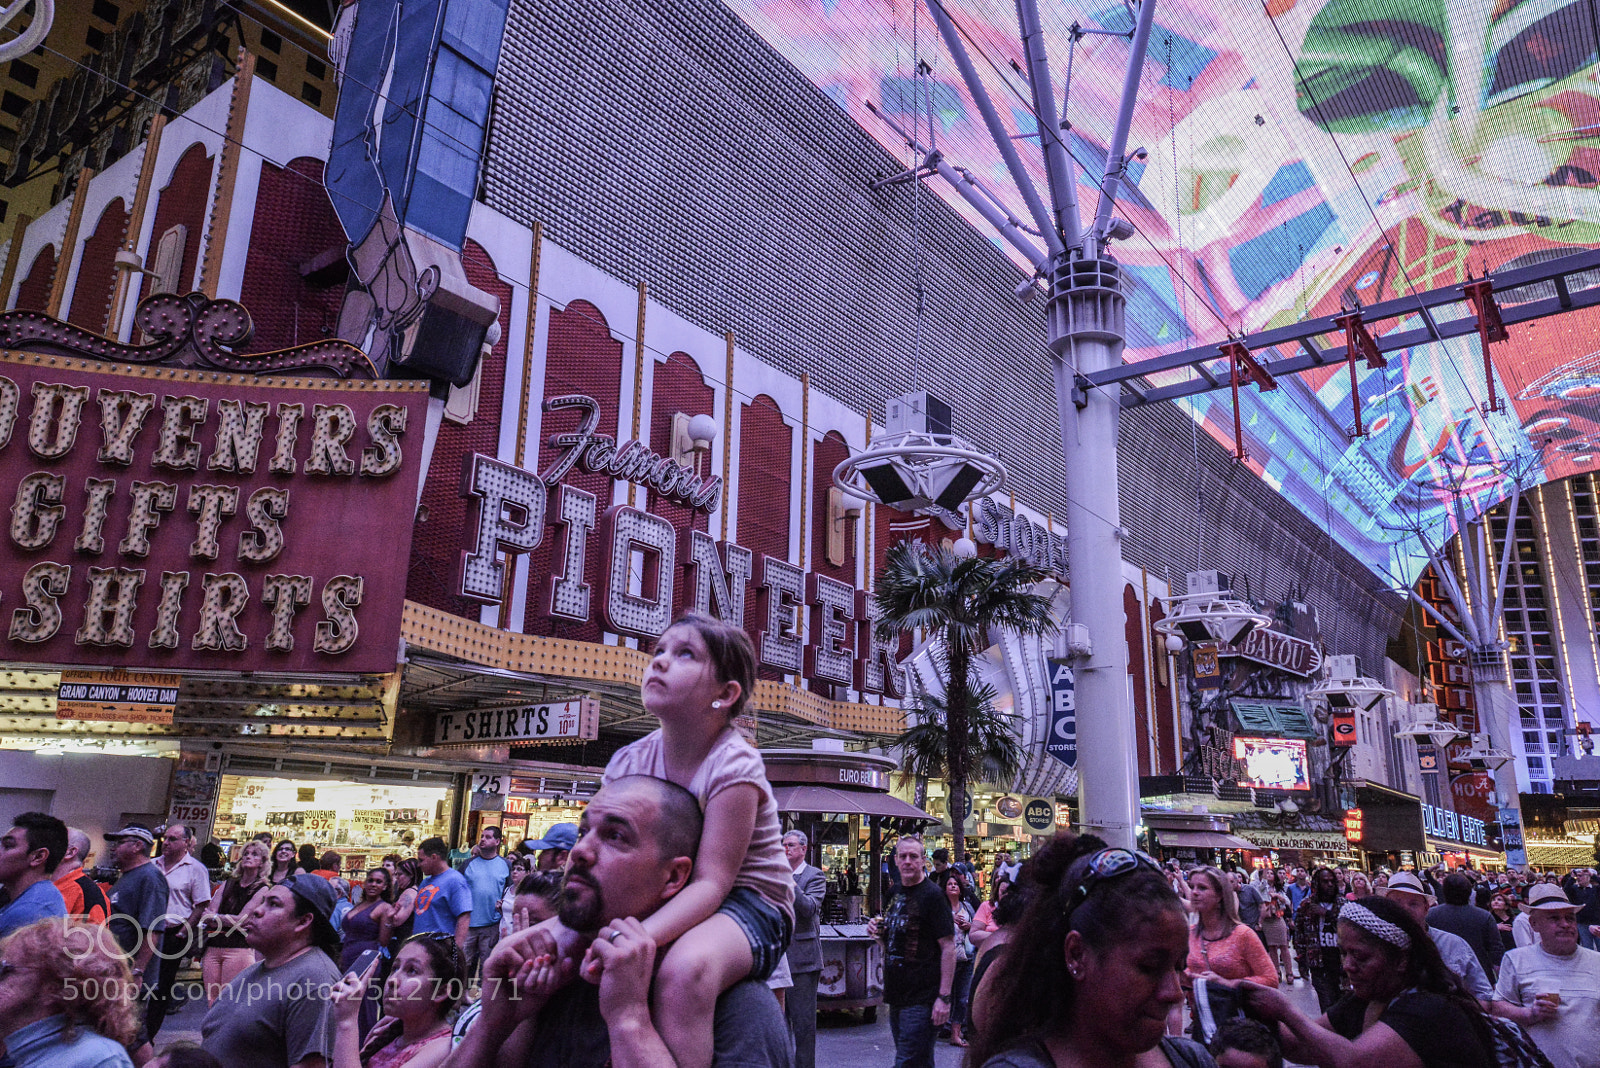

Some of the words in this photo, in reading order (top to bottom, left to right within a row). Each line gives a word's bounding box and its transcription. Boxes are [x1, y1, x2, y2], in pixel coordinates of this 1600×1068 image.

[541, 394, 723, 514] Famous
[10, 471, 291, 564] GIFTS
[456, 451, 906, 699] PIONEER
[1244, 629, 1306, 670] BAYOU
[65, 670, 93, 679] OFFICIAL
[99, 670, 129, 682] TOUR
[134, 672, 178, 685] CENTER
[60, 684, 88, 699] GRAND
[88, 686, 121, 700] CANYON
[127, 688, 159, 702] HOOVER
[159, 689, 178, 703] DAM
[563, 702, 570, 713] 4
[1052, 664, 1076, 740] ABC
[95, 712, 117, 720] PASSES
[130, 713, 148, 721] SHOW
[150, 714, 172, 722] TICKETS
[441, 706, 550, 741] T-SHIRTS
[839, 768, 859, 783] EURO
[172, 805, 209, 820] $17.99
[354, 809, 385, 818] EVERYTHING
[507, 799, 525, 813] TM
[1027, 807, 1050, 817] ABC
[304, 810, 337, 820] SOUVENIRS
[1421, 802, 1461, 841] OLDEN
[1460, 814, 1488, 846] GATE
[1277, 838, 1289, 848] NEW
